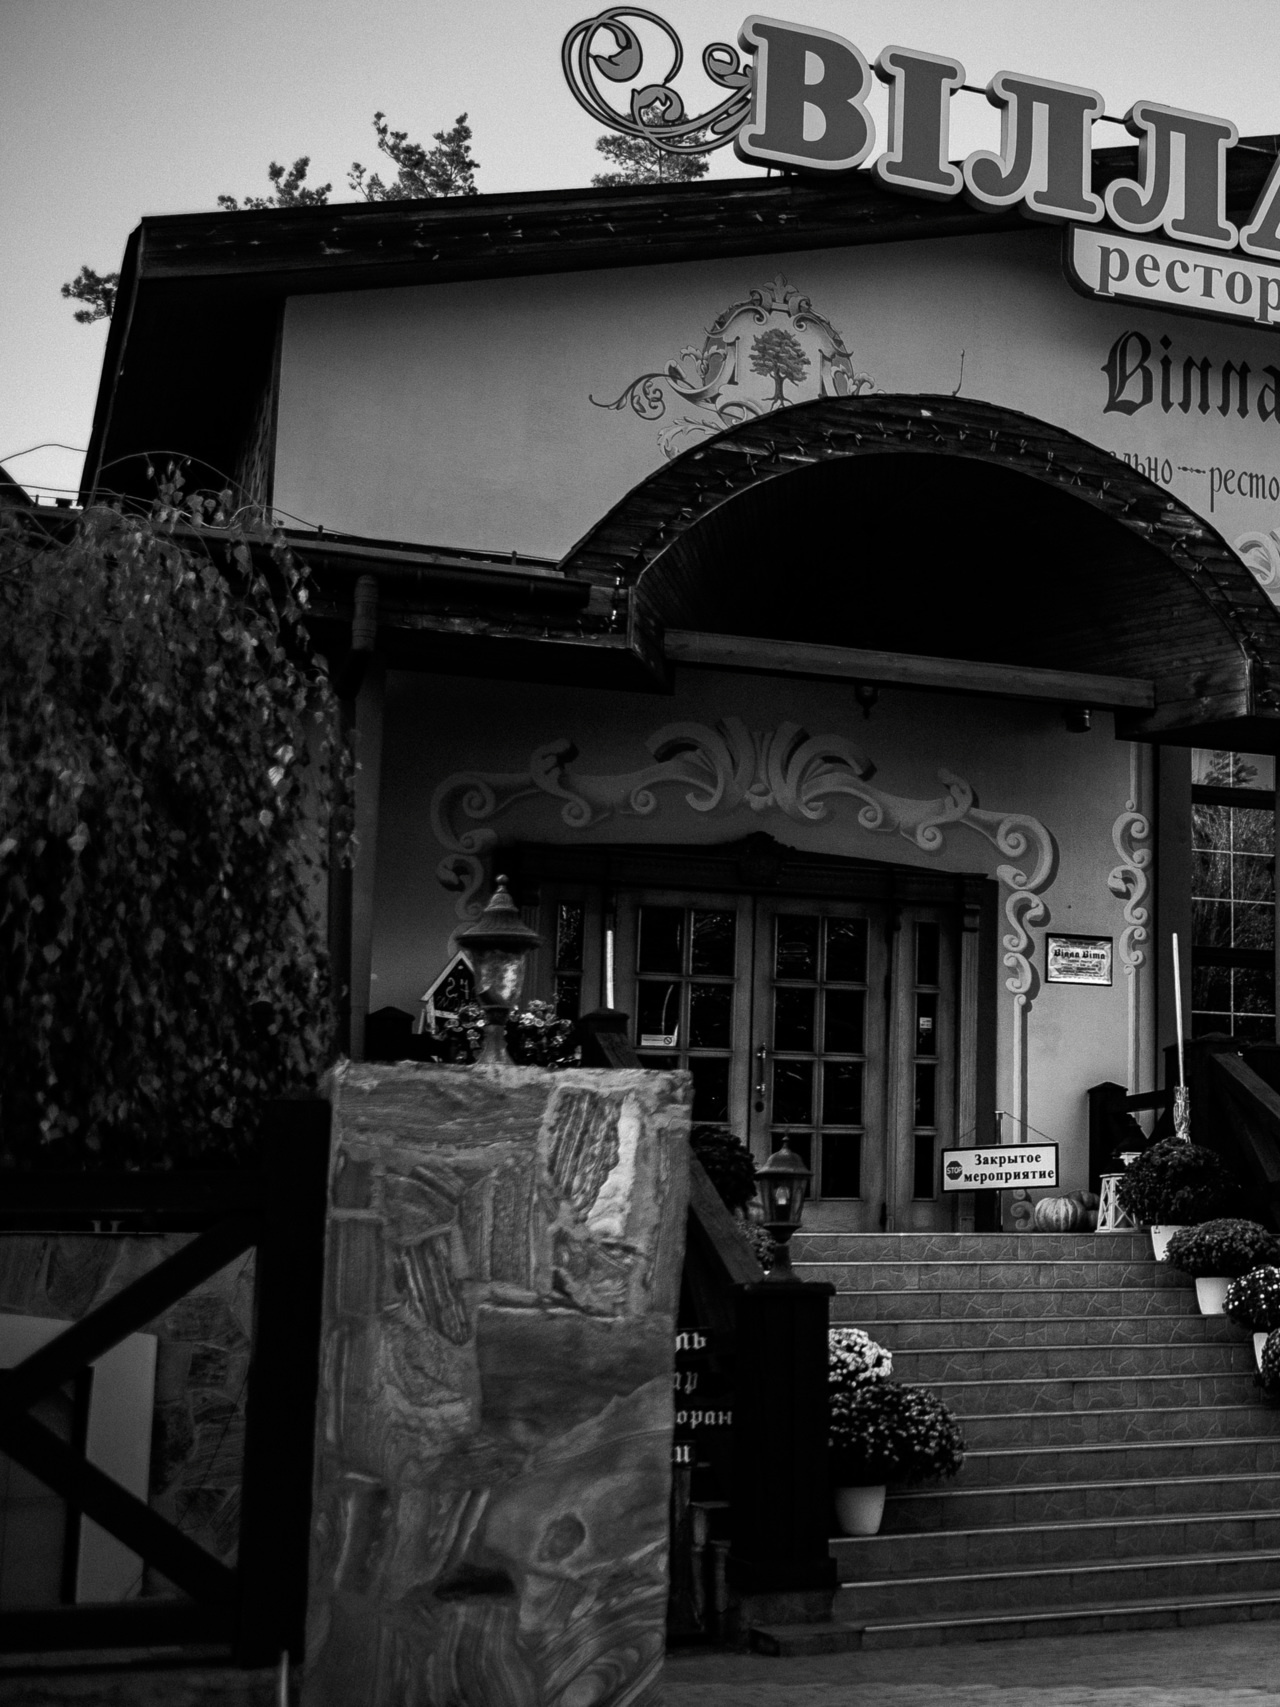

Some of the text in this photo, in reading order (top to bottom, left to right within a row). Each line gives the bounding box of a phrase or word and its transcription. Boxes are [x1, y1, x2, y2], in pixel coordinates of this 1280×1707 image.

[974, 1153, 1042, 1167] Закрытое
[946, 1166, 963, 1174] STOP
[964, 1169, 1055, 1184] мероприятие
